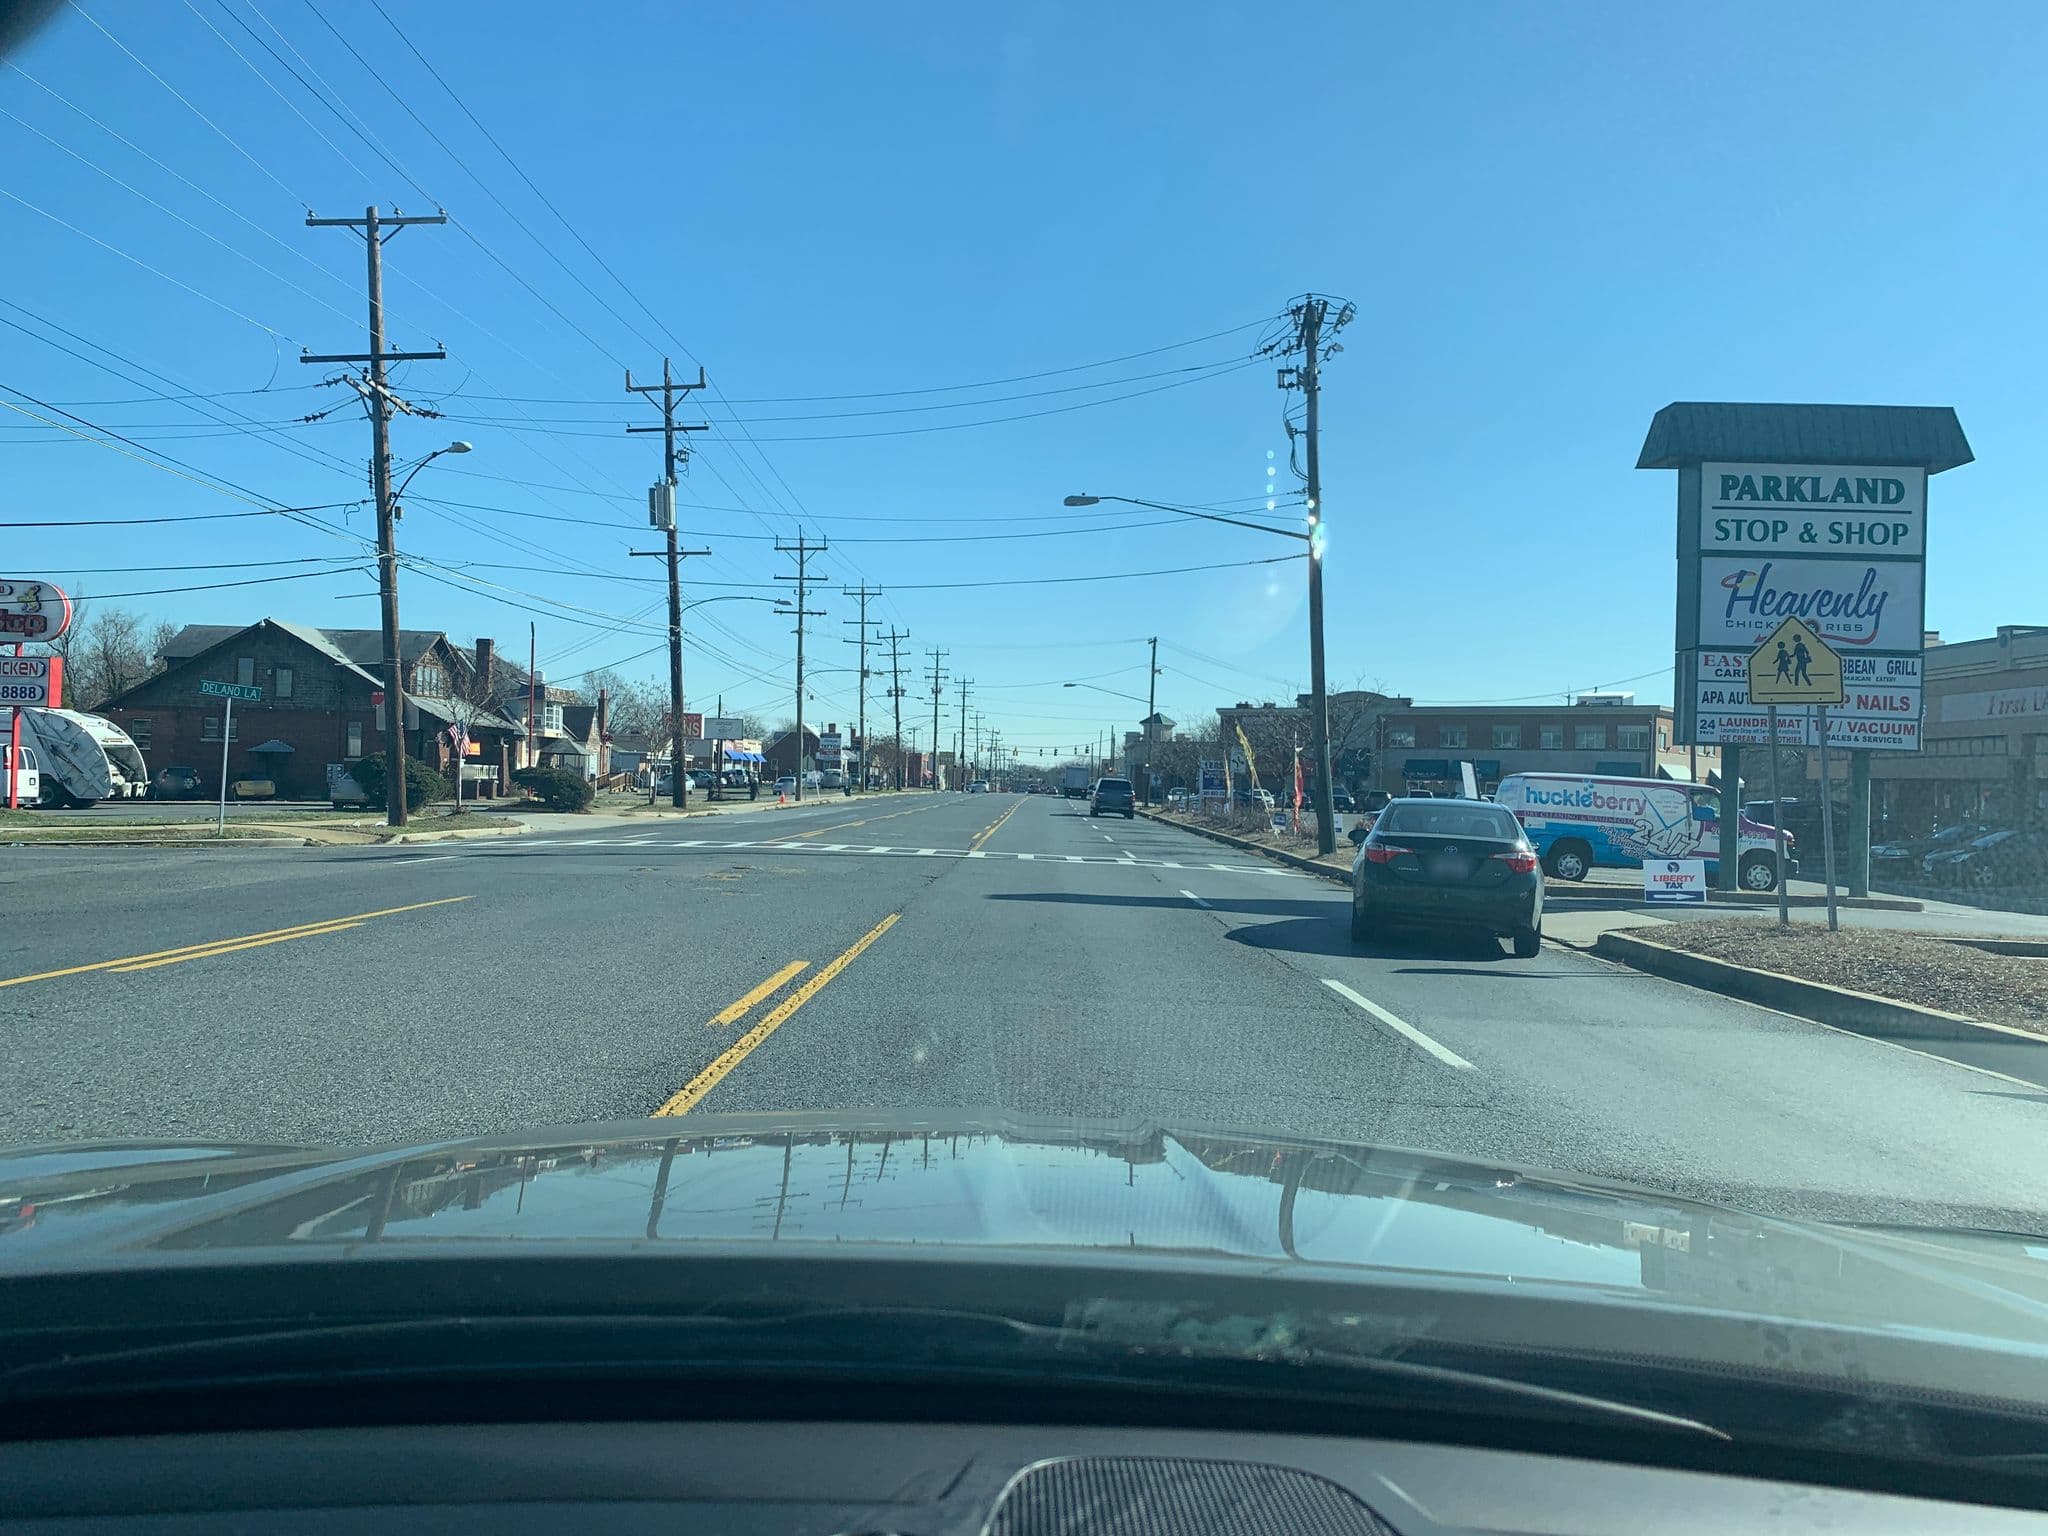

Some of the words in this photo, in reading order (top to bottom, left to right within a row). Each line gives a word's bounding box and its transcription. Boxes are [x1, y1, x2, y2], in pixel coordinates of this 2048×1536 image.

[1719, 474, 1905, 505] PARKLAND
[1715, 518, 1788, 543] STOP
[1799, 522, 1819, 544] &
[1828, 521, 1909, 546] SHOP
[1721, 562, 1888, 636] Heavenly
[1826, 622, 1863, 632] RIBS
[1703, 654, 1750, 667] EAS
[1886, 660, 1918, 676] GRILL
[201, 682, 241, 697] DELANO
[244, 687, 258, 699] LA
[1702, 690, 1725, 704] APA
[1856, 694, 1911, 712] NAILS
[1699, 719, 1716, 730] 24
[1719, 717, 1803, 729] LAUNDRMAT
[1847, 721, 1916, 736] VACUUM
[1720, 734, 1731, 742] ICE
[1733, 735, 1757, 743] CREAM
[1862, 736, 1903, 744] SERVICES
[1525, 786, 1647, 816] huckleberry
[1653, 875, 1696, 884] LIBERTY
[1664, 882, 1684, 890] TAX
